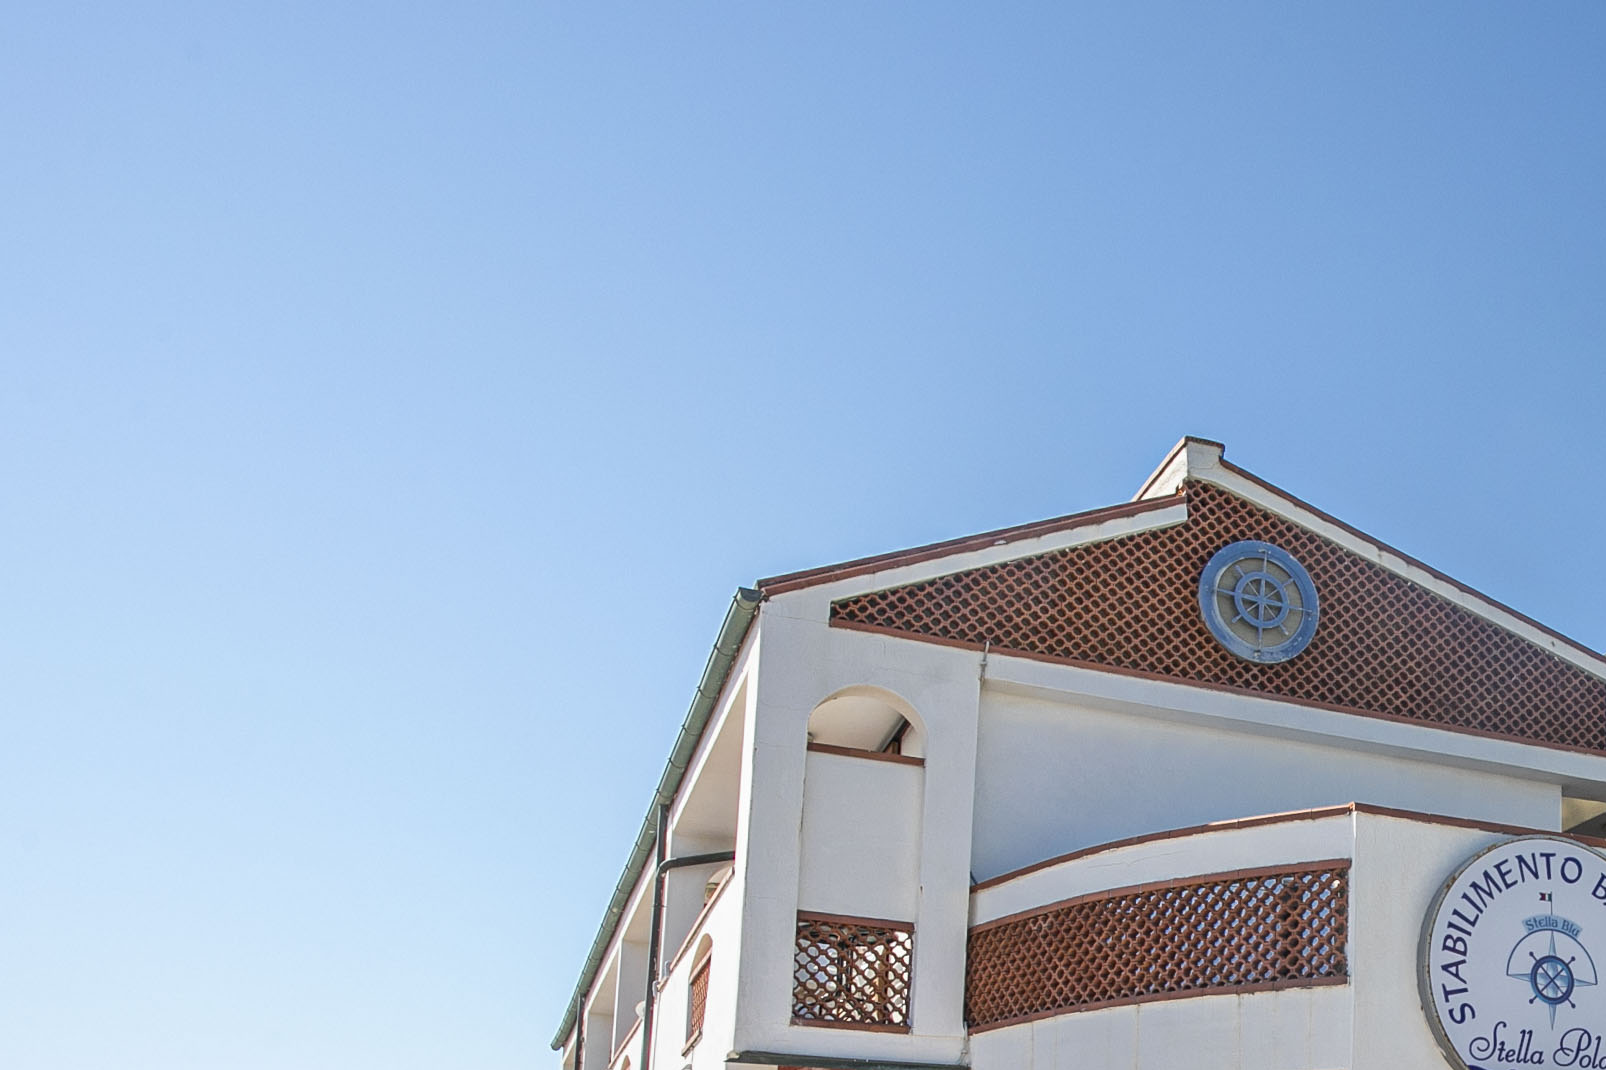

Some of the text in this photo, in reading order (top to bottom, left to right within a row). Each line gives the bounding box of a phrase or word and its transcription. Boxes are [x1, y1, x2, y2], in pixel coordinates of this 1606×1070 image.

[1440, 852, 1584, 1025] STABILIMENTO
[1524, 917, 1559, 931] Stella
[1468, 1020, 1545, 1065] Stella
